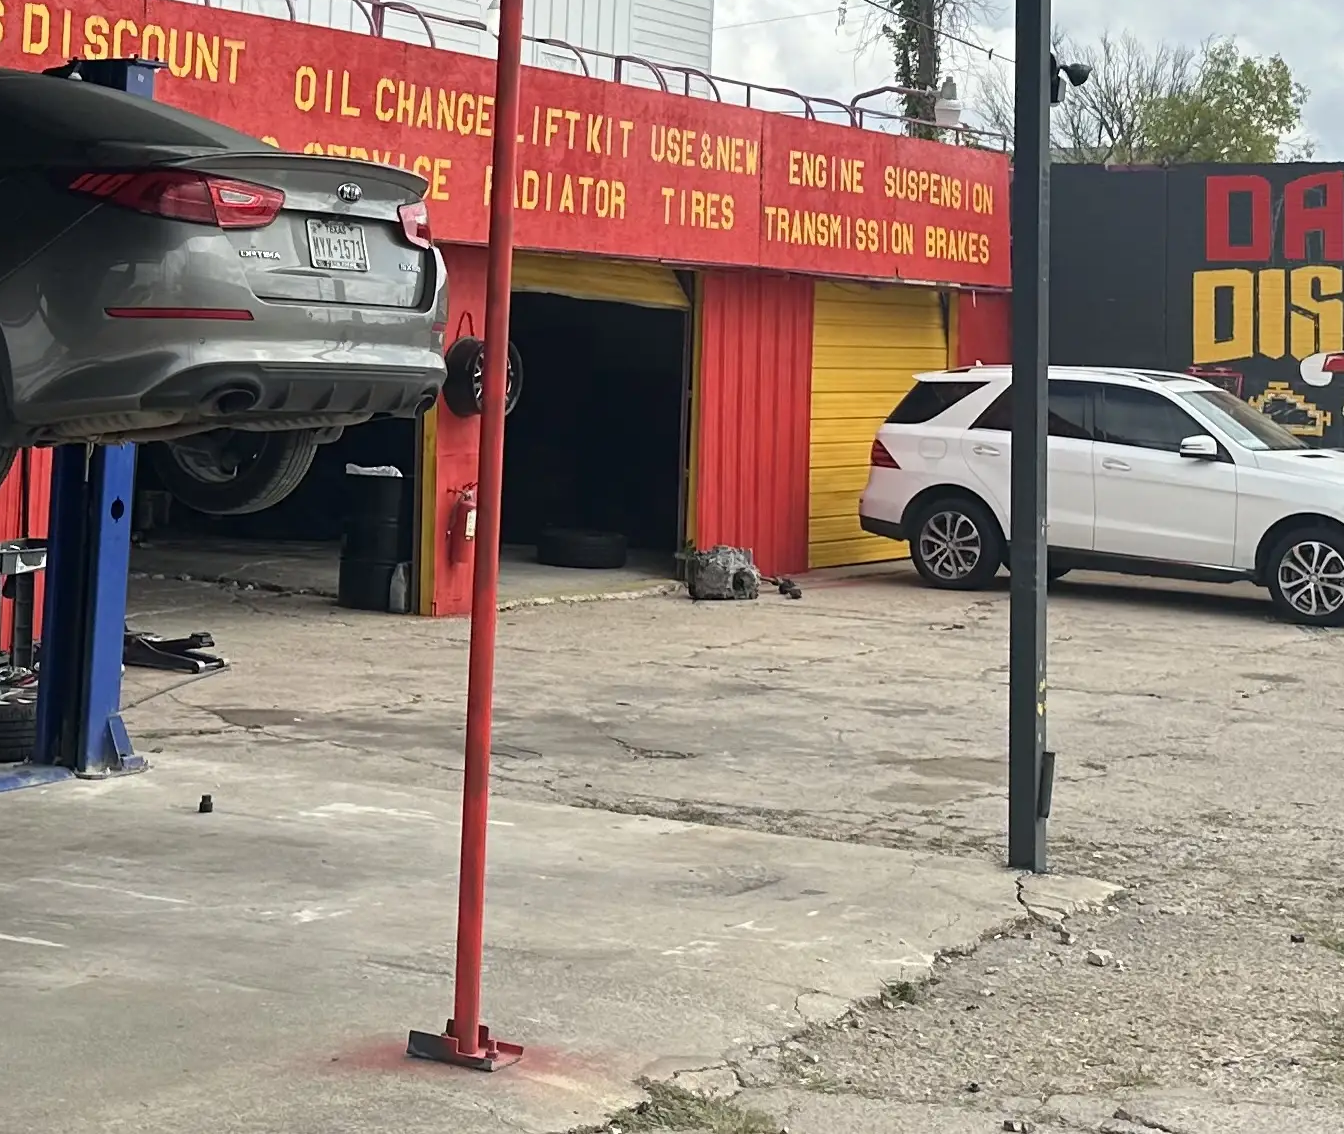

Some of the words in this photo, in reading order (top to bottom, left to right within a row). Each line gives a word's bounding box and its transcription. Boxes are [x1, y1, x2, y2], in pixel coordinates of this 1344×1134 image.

[22, 2, 246, 85] DISCOUNT
[294, 65, 361, 117] OIL
[375, 77, 495, 137] CHANGE
[483, 165, 626, 219] DIATOR
[789, 150, 865, 194] ENGINE
[884, 165, 993, 215] SUSPENSION
[661, 186, 735, 230] TIRES
[764, 206, 914, 255] TRANSMISSION
[925, 225, 990, 265] BRAKES
